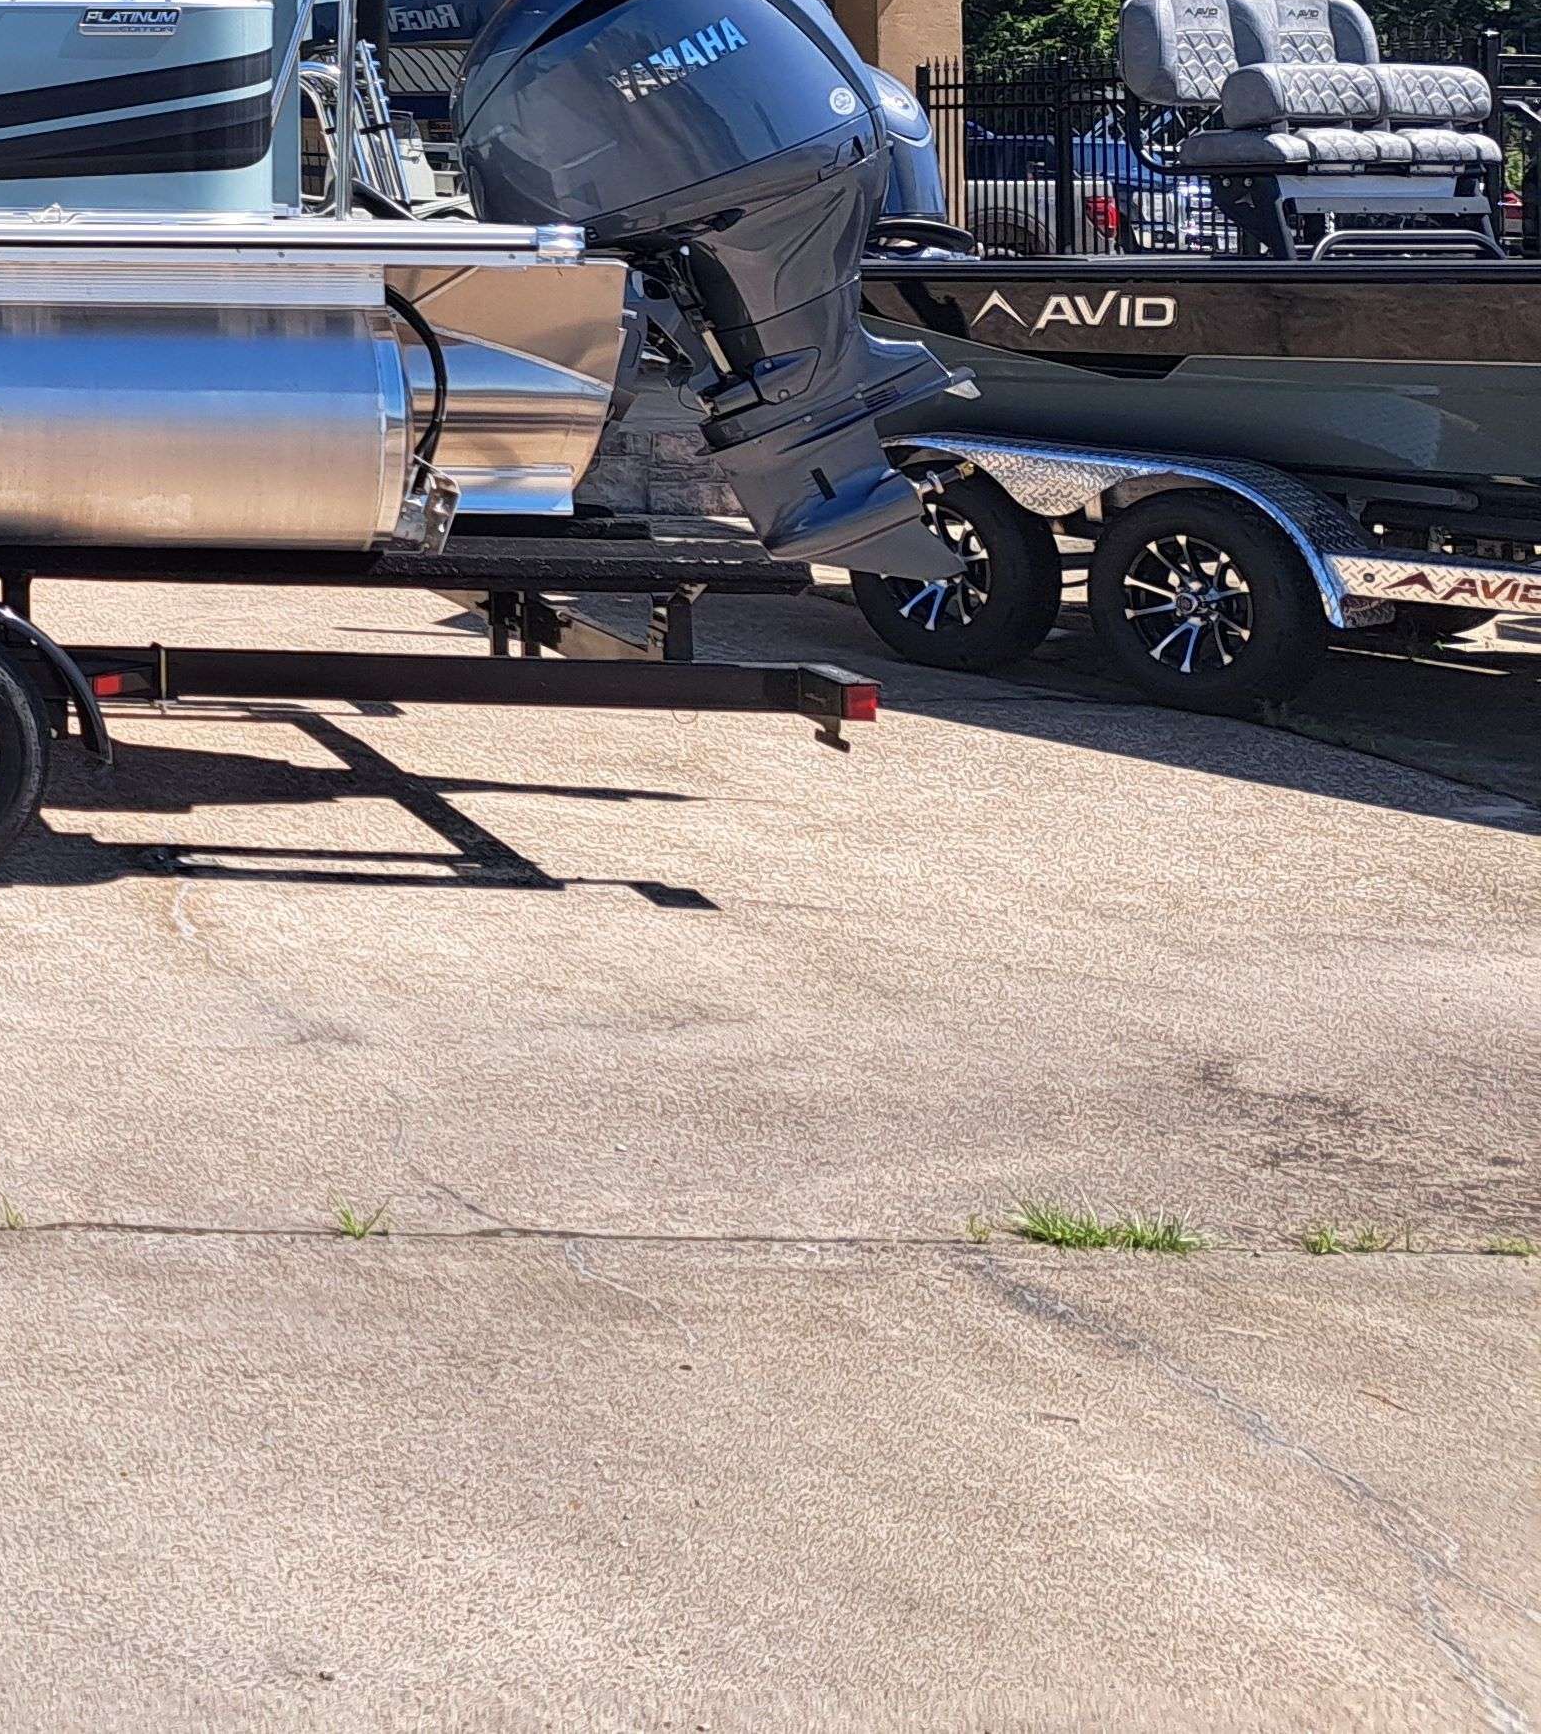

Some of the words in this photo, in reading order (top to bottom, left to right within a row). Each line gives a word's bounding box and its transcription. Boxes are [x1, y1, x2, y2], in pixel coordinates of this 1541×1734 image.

[85, 10, 178, 23] PLATINUM
[607, 16, 749, 104] YAMAHA
[1029, 290, 1177, 338] AVID
